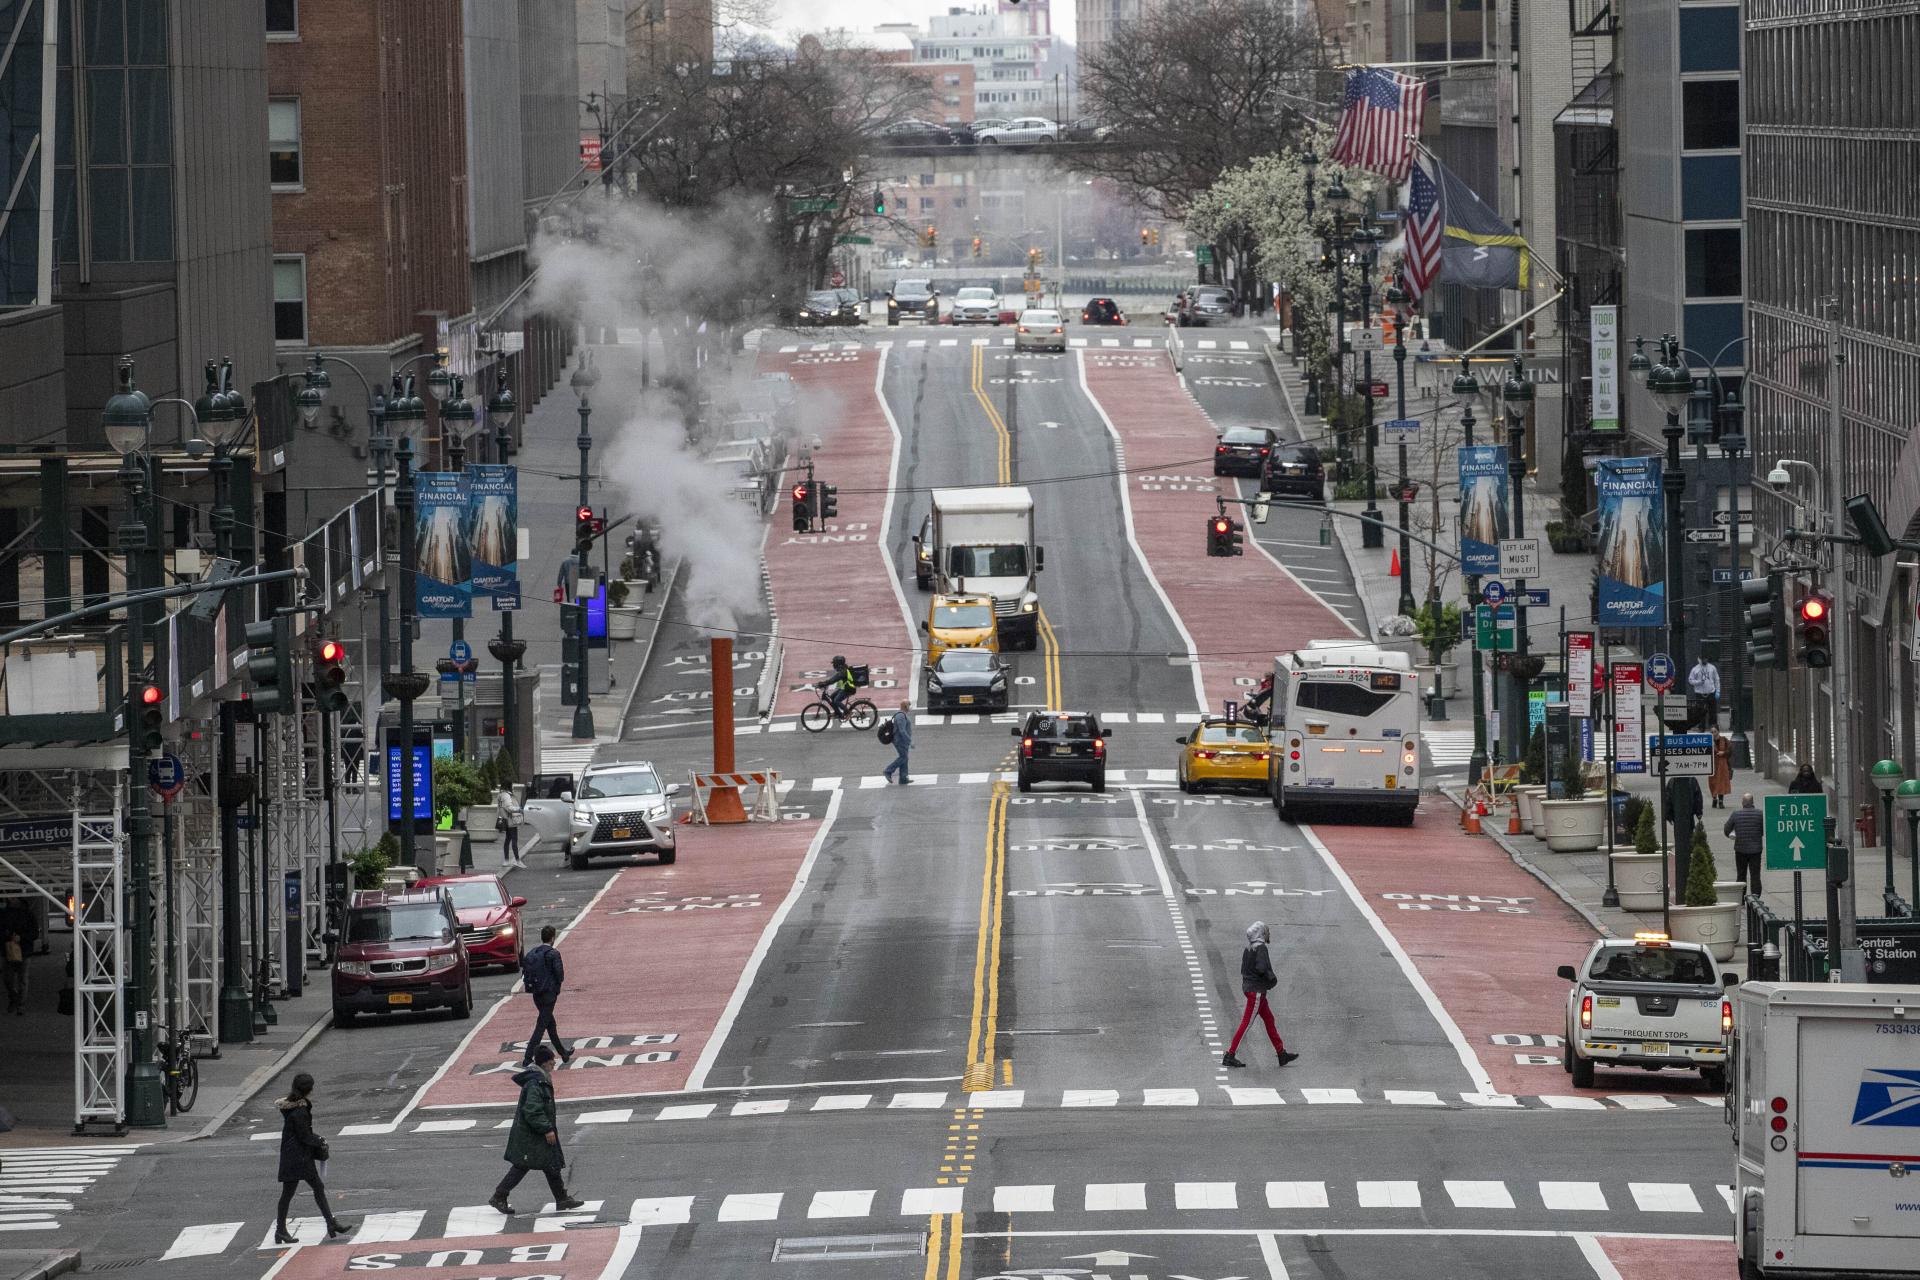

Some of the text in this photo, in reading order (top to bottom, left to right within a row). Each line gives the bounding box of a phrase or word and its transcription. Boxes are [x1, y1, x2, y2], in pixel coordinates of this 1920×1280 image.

[1594, 313, 1613, 325] FOOD
[1598, 348, 1611, 360] FOR
[1481, 366, 1559, 382] WETIN
[1600, 383, 1611, 394] ALL
[1602, 481, 1658, 490] FINANCIAL
[419, 492, 467, 500] FINANCIAL
[780, 534, 867, 545] ONLY
[1509, 555, 1529, 563] MUST
[473, 576, 501, 584] CANTOR
[421, 595, 454, 603] CANTOR
[1348, 674, 1369, 682] 4124
[1686, 737, 1709, 745] LANE
[1686, 747, 1707, 755] ONLY
[1674, 761, 1708, 770] 7AM-7PM
[1779, 804, 1813, 816] F.D.R.
[1777, 820, 1815, 832] DRIVE
[0, 826, 73, 842] Lexington
[289, 887, 296, 899] P
[1185, 888, 1337, 896] ONLY
[1382, 893, 1536, 904] ONLY
[607, 901, 762, 914] ONLY
[1397, 903, 1531, 913] BUS
[1875, 948, 1917, 960] Station
[1875, 962, 1883, 971] S
[1623, 1029, 1663, 1038] FREQUENT
[1664, 1031, 1689, 1039] STOPS
[471, 1051, 673, 1076] ONY
[349, 1243, 569, 1270] BUS
